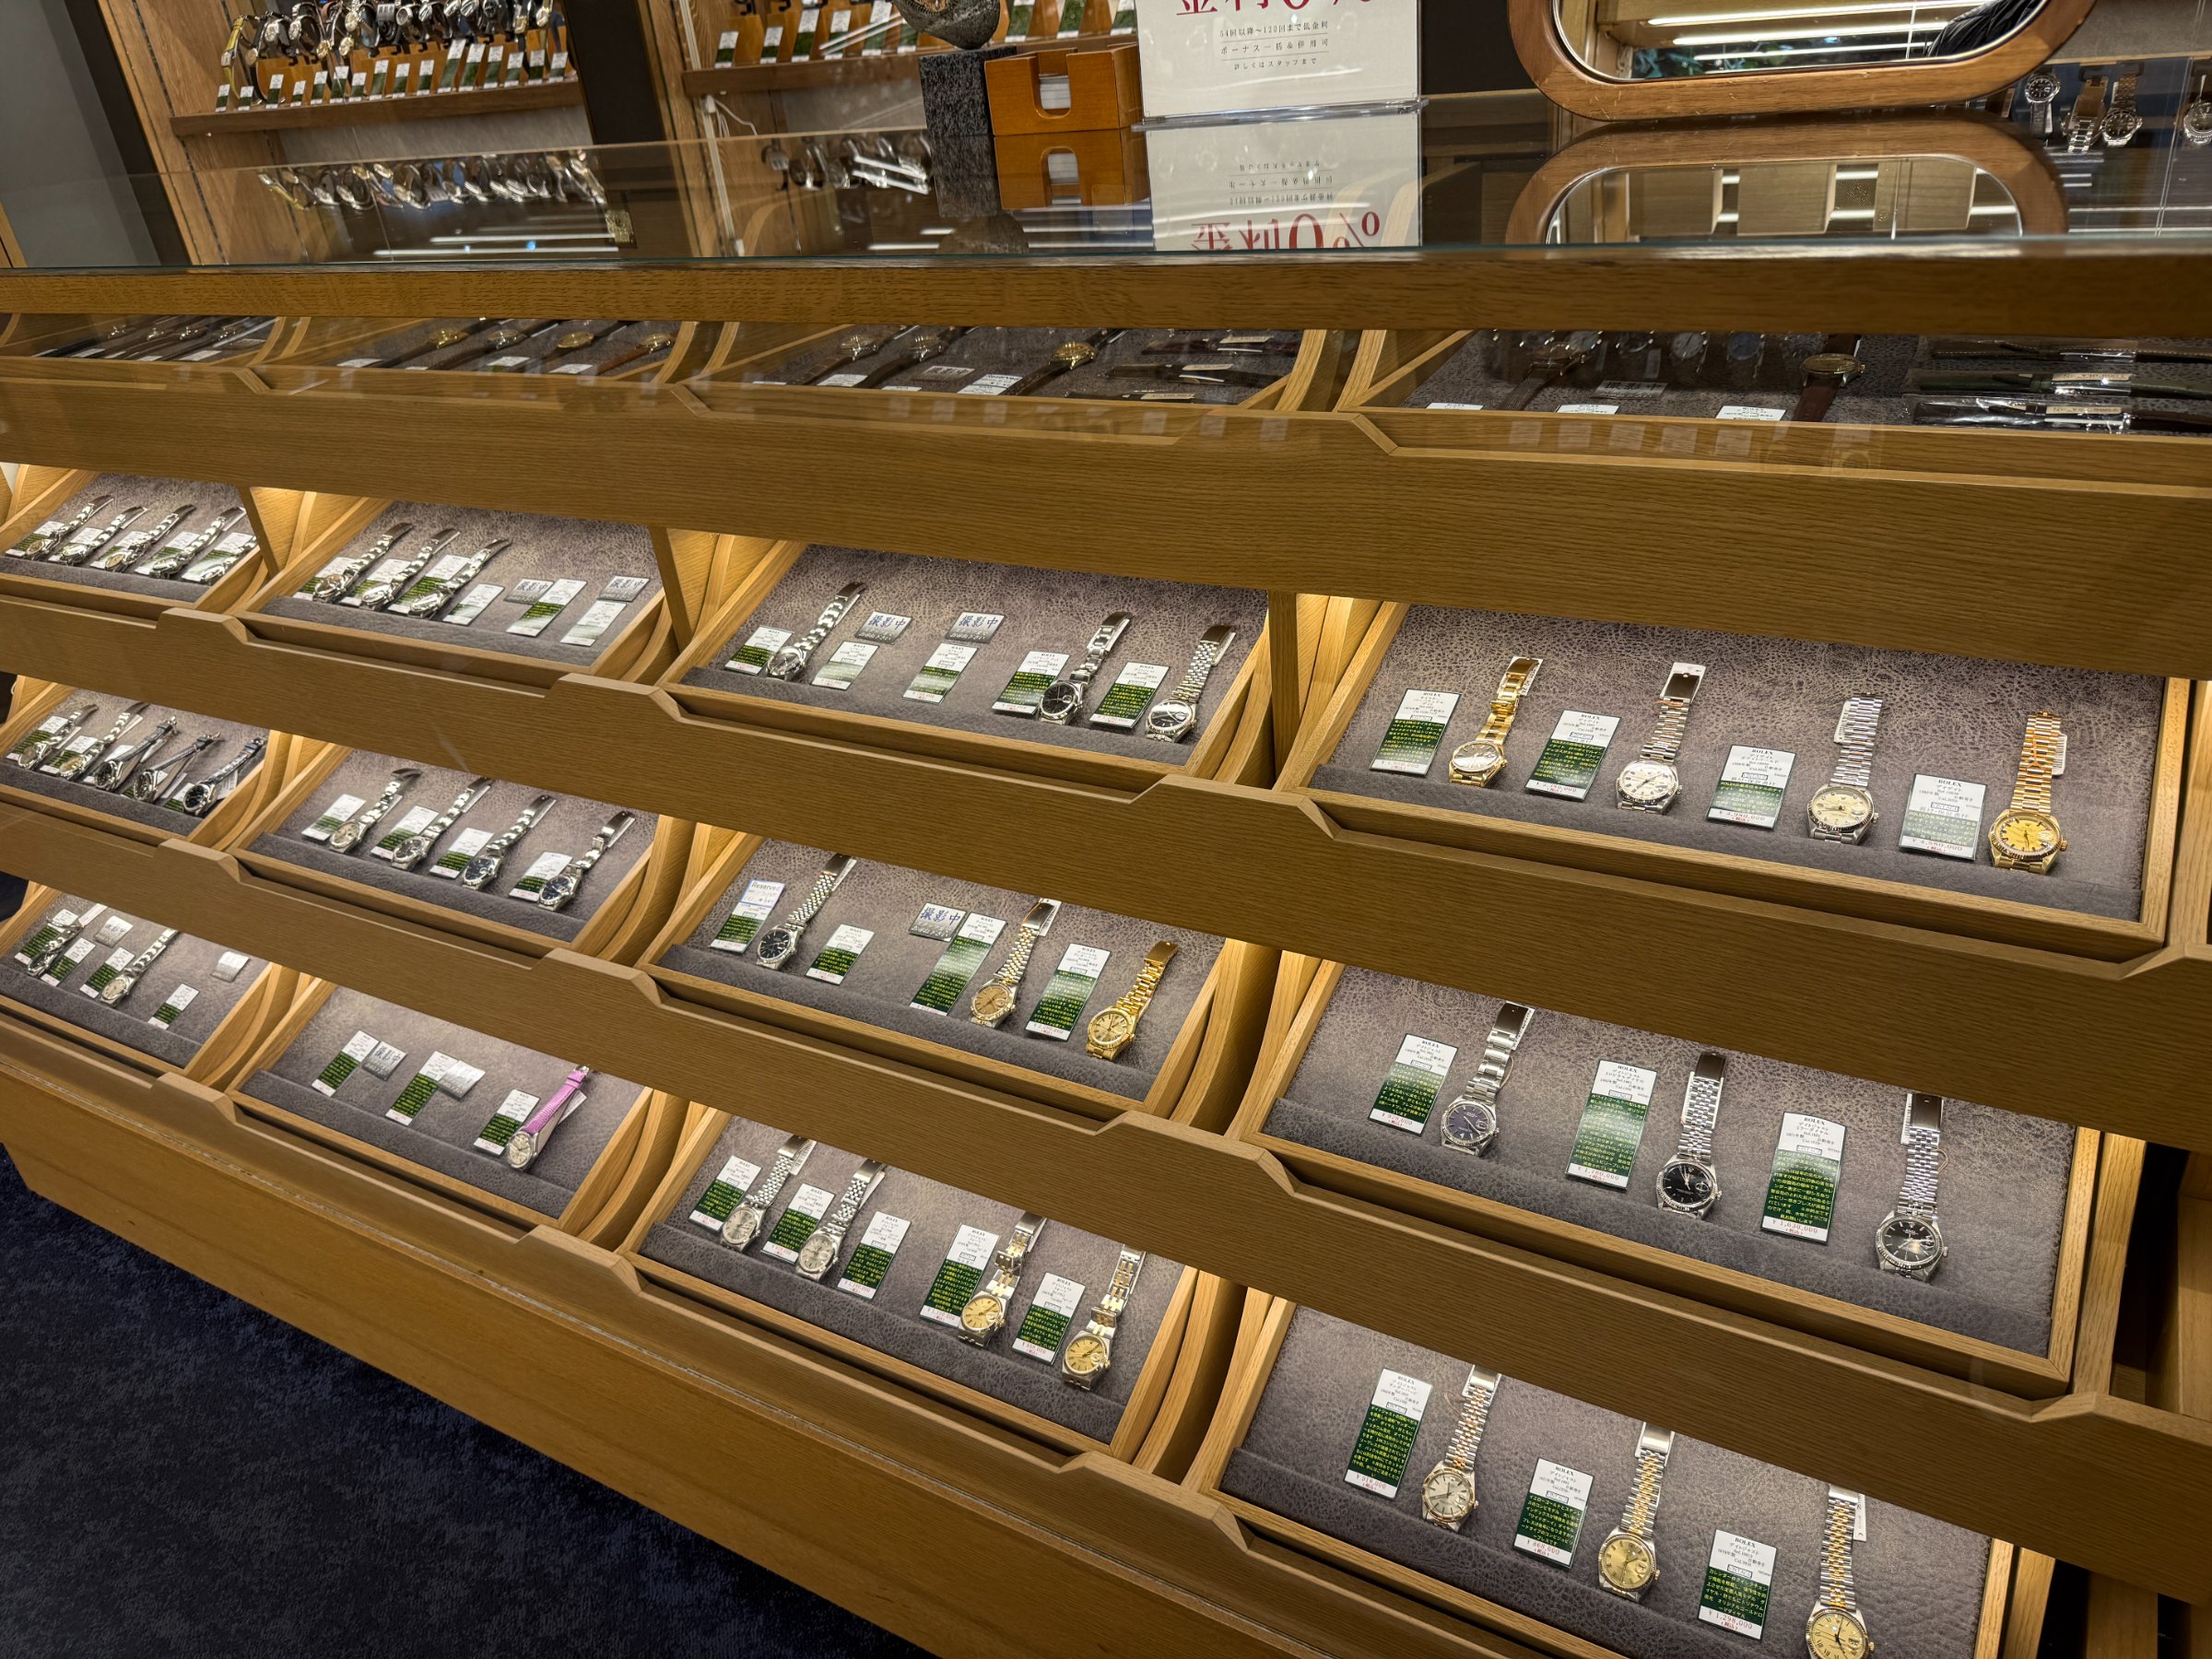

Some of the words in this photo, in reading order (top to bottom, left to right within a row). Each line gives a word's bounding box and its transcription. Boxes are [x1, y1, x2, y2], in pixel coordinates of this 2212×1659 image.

[867, 615, 906, 630] 撮影中
[959, 615, 998, 629] 撮影中
[1937, 779, 1961, 787] ROLEX
[920, 906, 960, 925] 撮影中
[1617, 1065, 1637, 1073] ROLEX
[1804, 1116, 1825, 1125] ROLEX
[1554, 1465, 1574, 1476] ROLEX
[1734, 1536, 1756, 1547] ROLEX
[1729, 1542, 1759, 1555] デイトジャスト
[1708, 1608, 1752, 1630] ¥1,298,000
